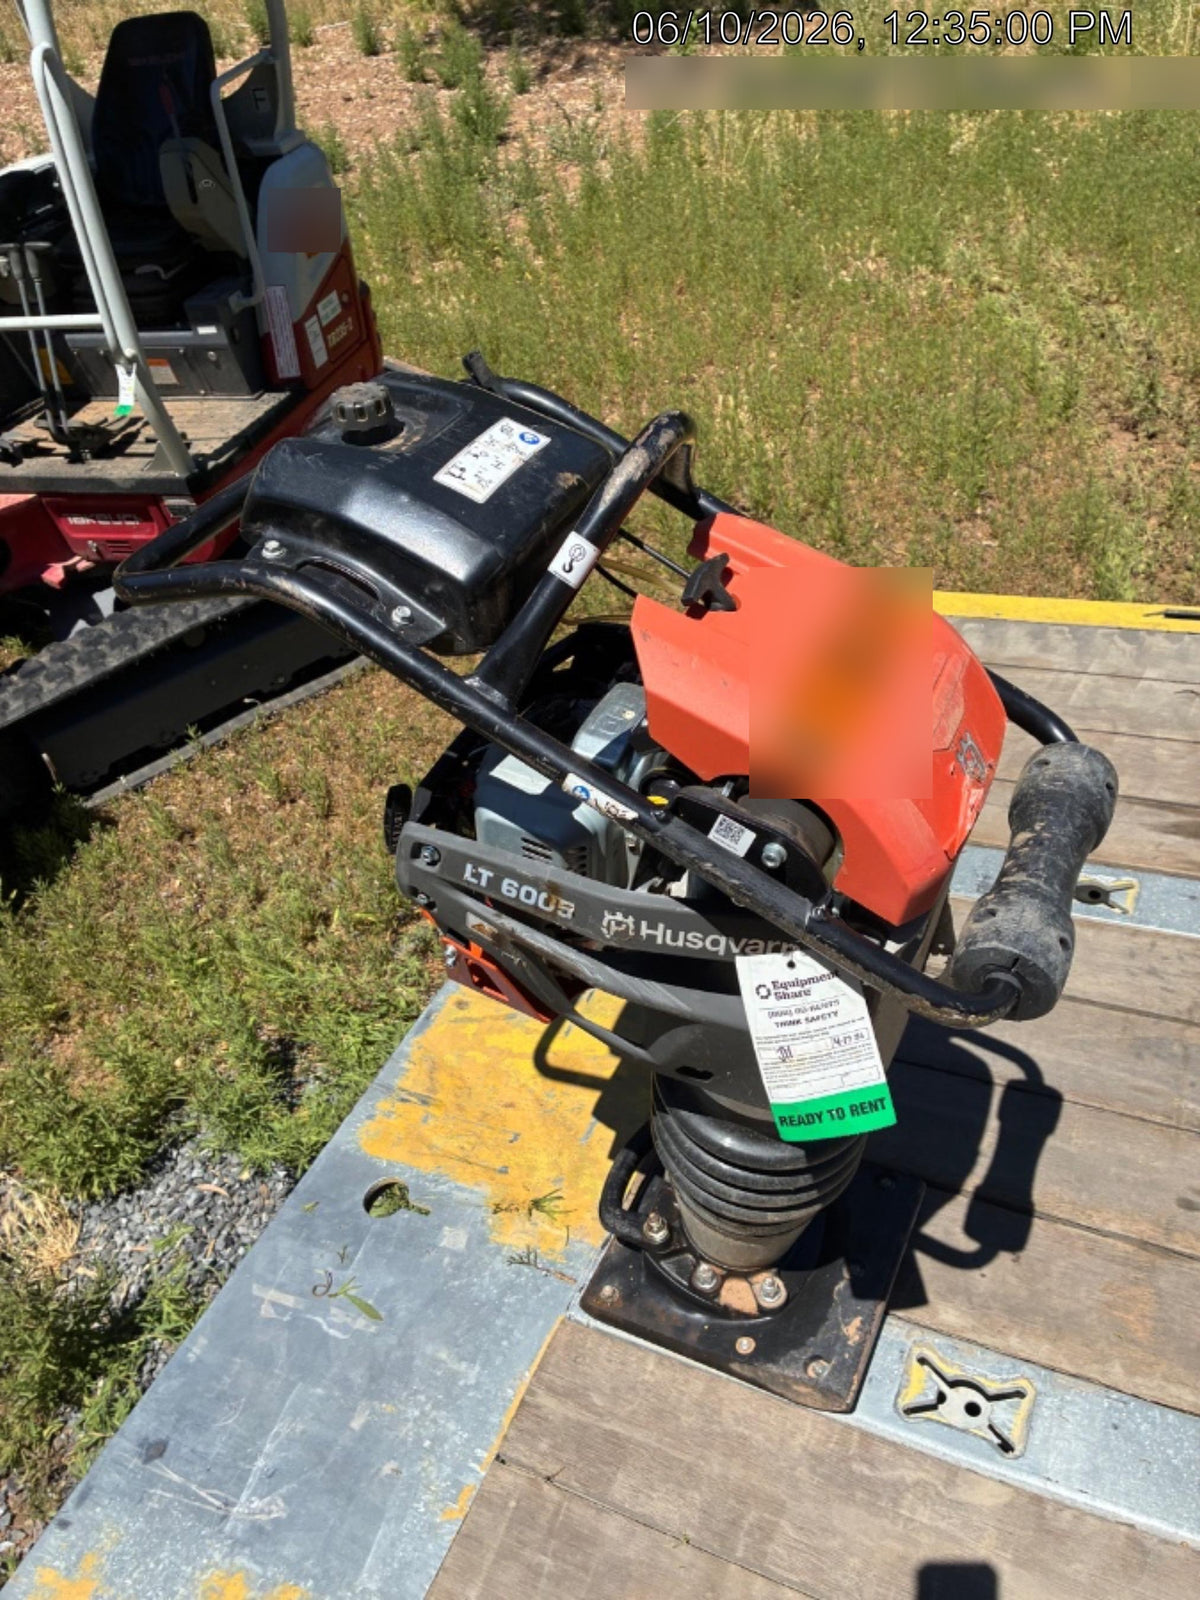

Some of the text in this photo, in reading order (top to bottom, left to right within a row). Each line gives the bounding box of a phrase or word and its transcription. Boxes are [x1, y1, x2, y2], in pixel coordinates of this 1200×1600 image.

[463, 863, 494, 888] LT
[640, 920, 800, 956] Husqvarn
[774, 989, 811, 1001] Share
[778, 1097, 886, 1127] READY TO RENT
